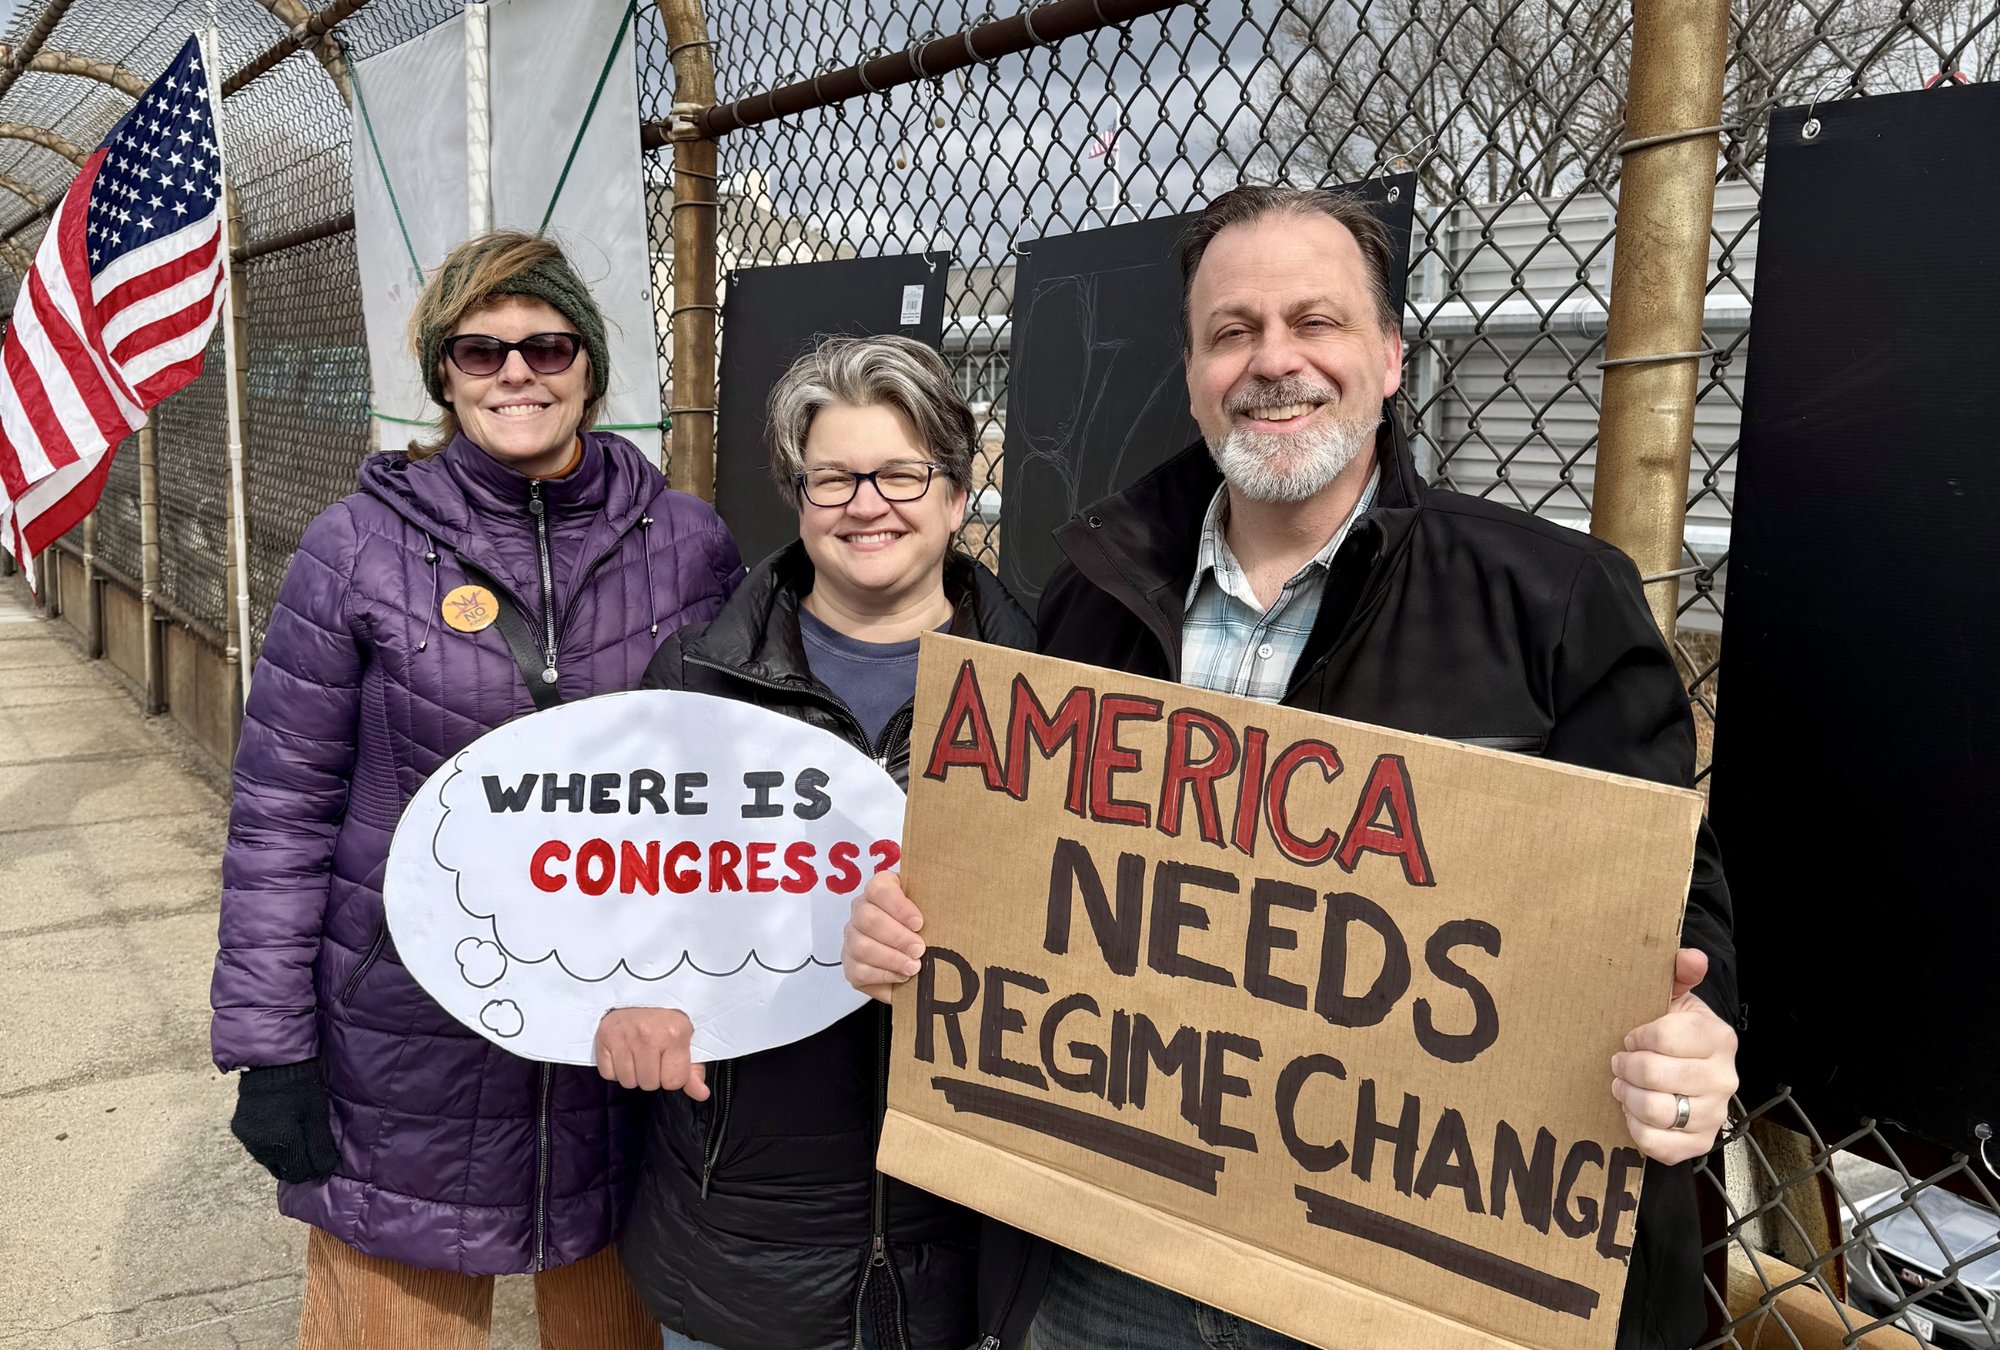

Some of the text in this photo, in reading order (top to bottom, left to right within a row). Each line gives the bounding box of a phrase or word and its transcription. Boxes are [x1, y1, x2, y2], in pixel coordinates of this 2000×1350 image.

[464, 607, 486, 622] NO
[481, 768, 832, 819] WHERE IS
[923, 659, 1437, 887] AMERICA
[1043, 838, 1500, 1064] NEEDS
[914, 946, 1646, 1267] REGIME CHANGE
